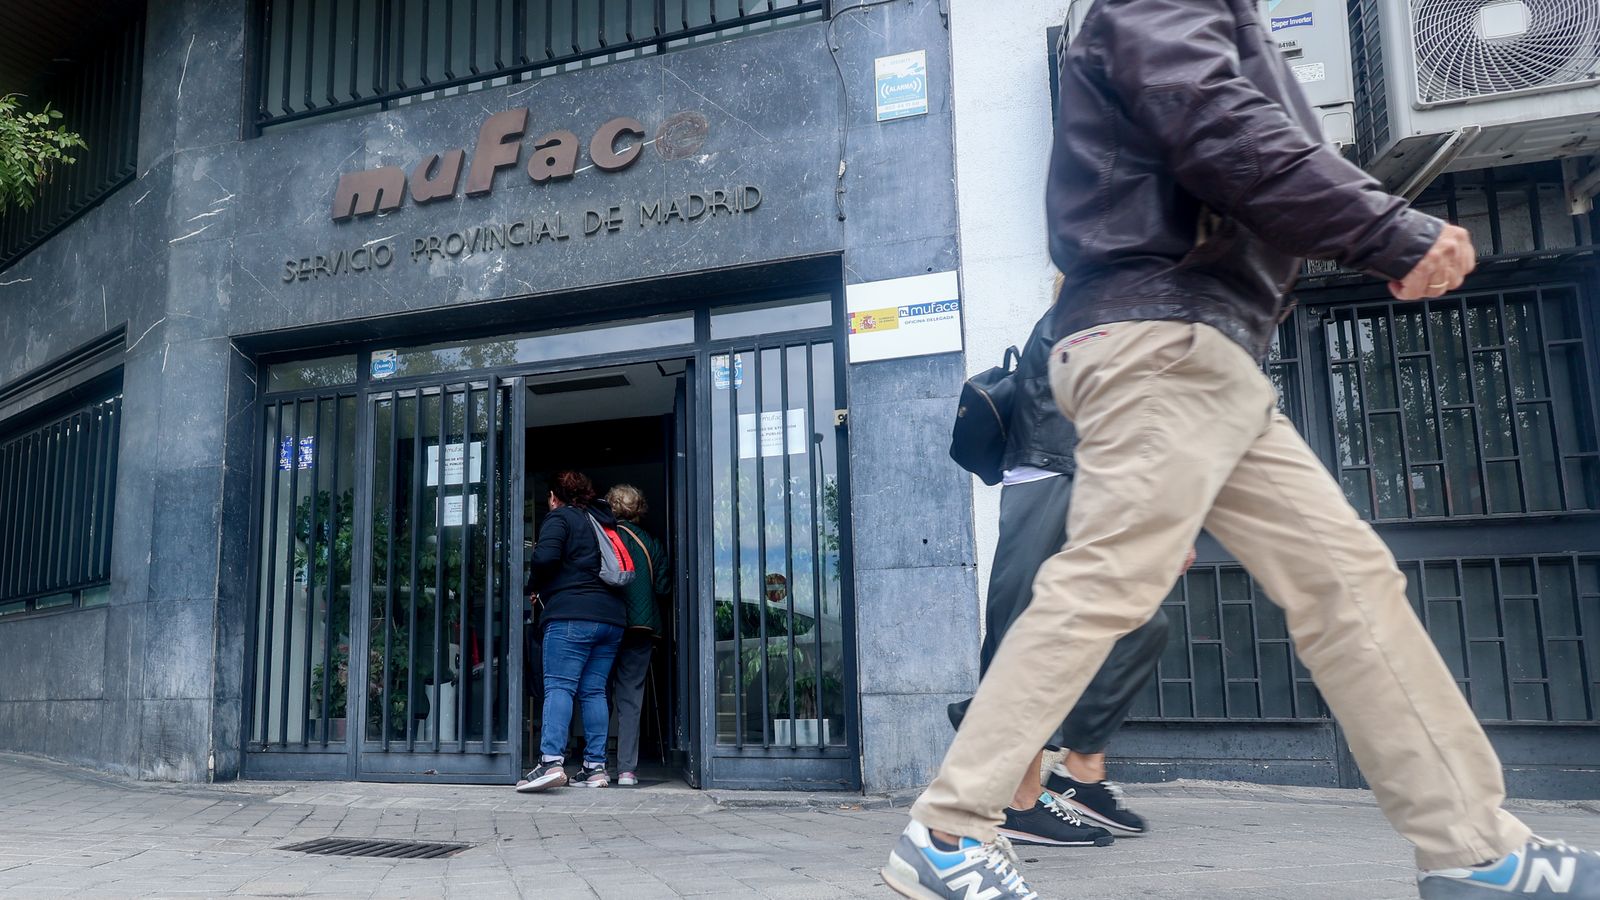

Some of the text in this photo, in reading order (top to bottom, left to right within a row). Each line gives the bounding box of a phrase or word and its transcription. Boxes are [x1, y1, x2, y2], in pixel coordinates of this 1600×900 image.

[1272, 16, 1312, 28] Super Inverter
[283, 185, 763, 282] SERVICIO PROVINCIAL DE MADRID
[910, 301, 959, 316] muface
